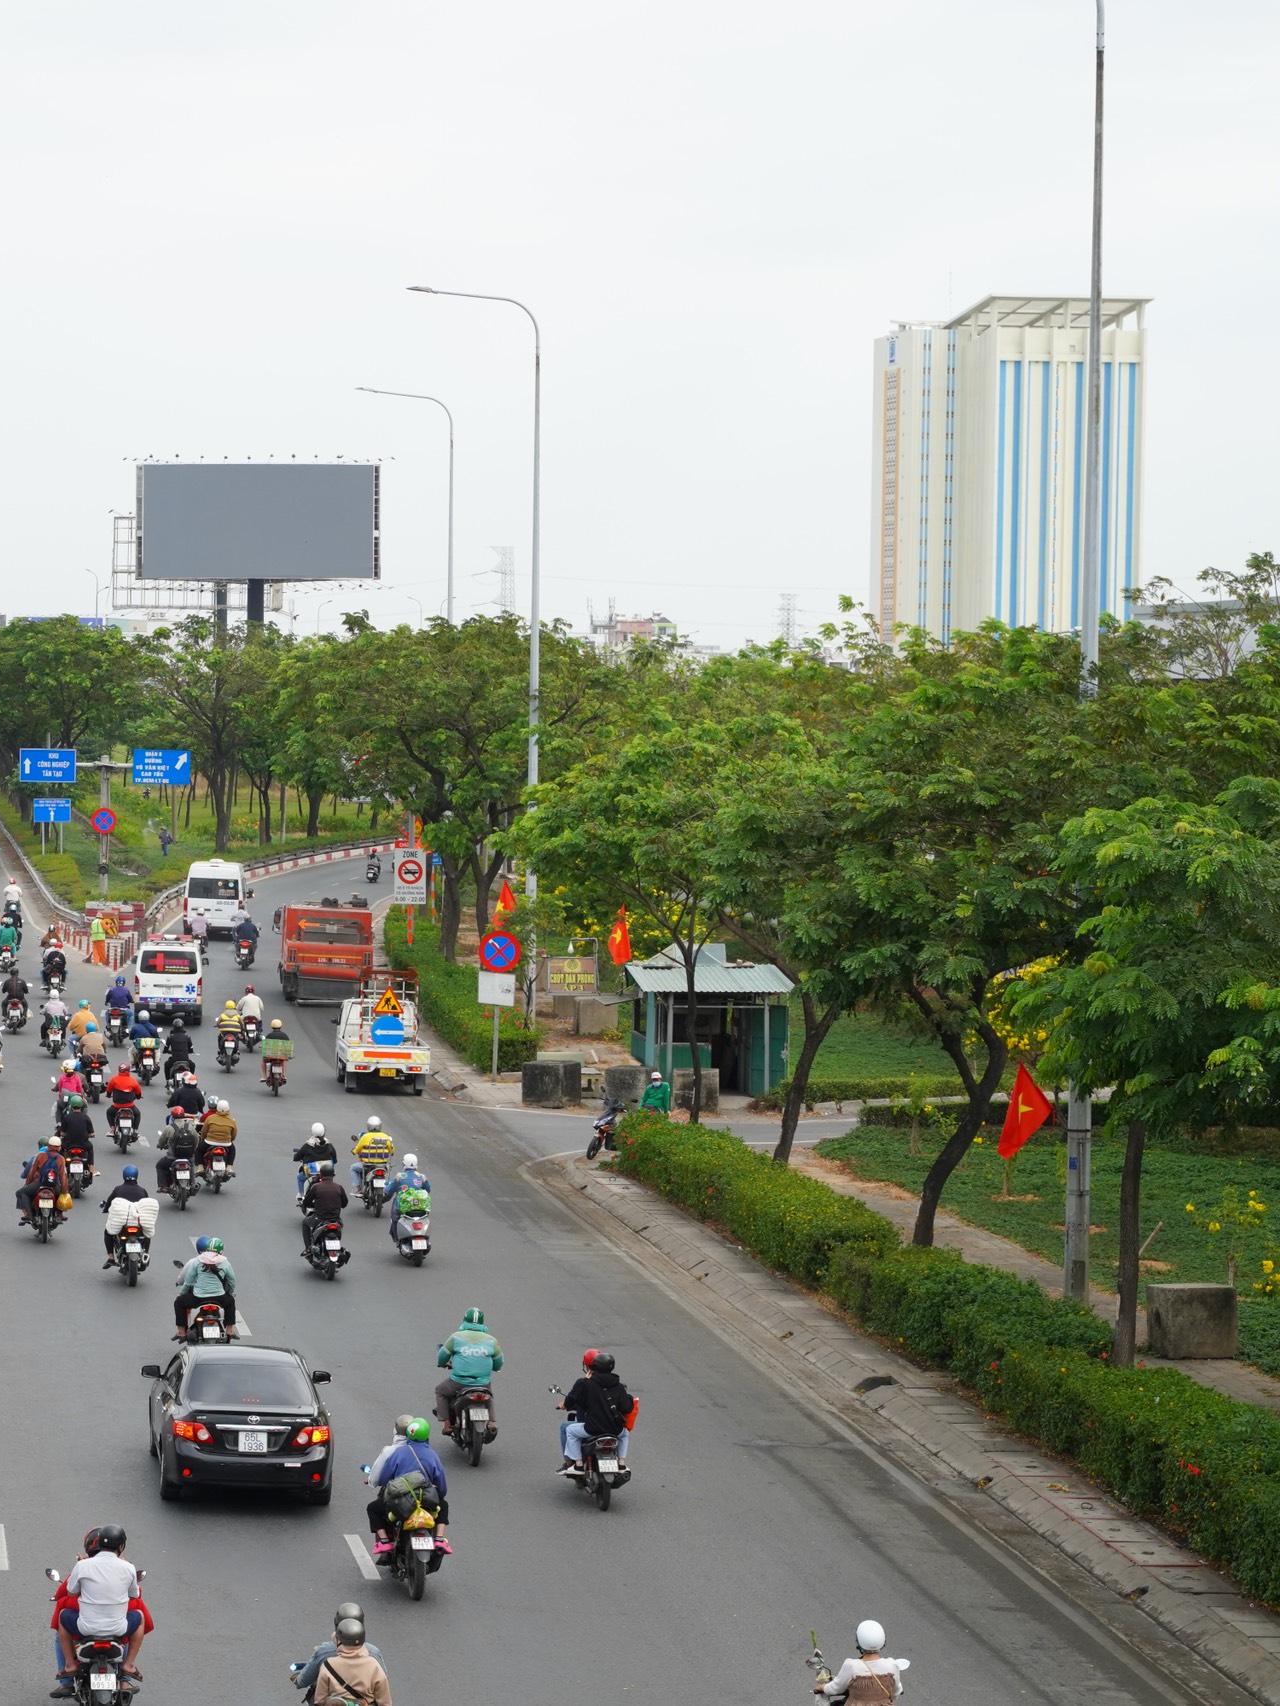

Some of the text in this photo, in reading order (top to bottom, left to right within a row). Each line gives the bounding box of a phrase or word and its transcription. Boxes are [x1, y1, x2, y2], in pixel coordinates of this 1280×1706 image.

[460, 1346, 488, 1356] Grab
[245, 1432, 261, 1442] 65L
[243, 1442, 264, 1451] 1936
